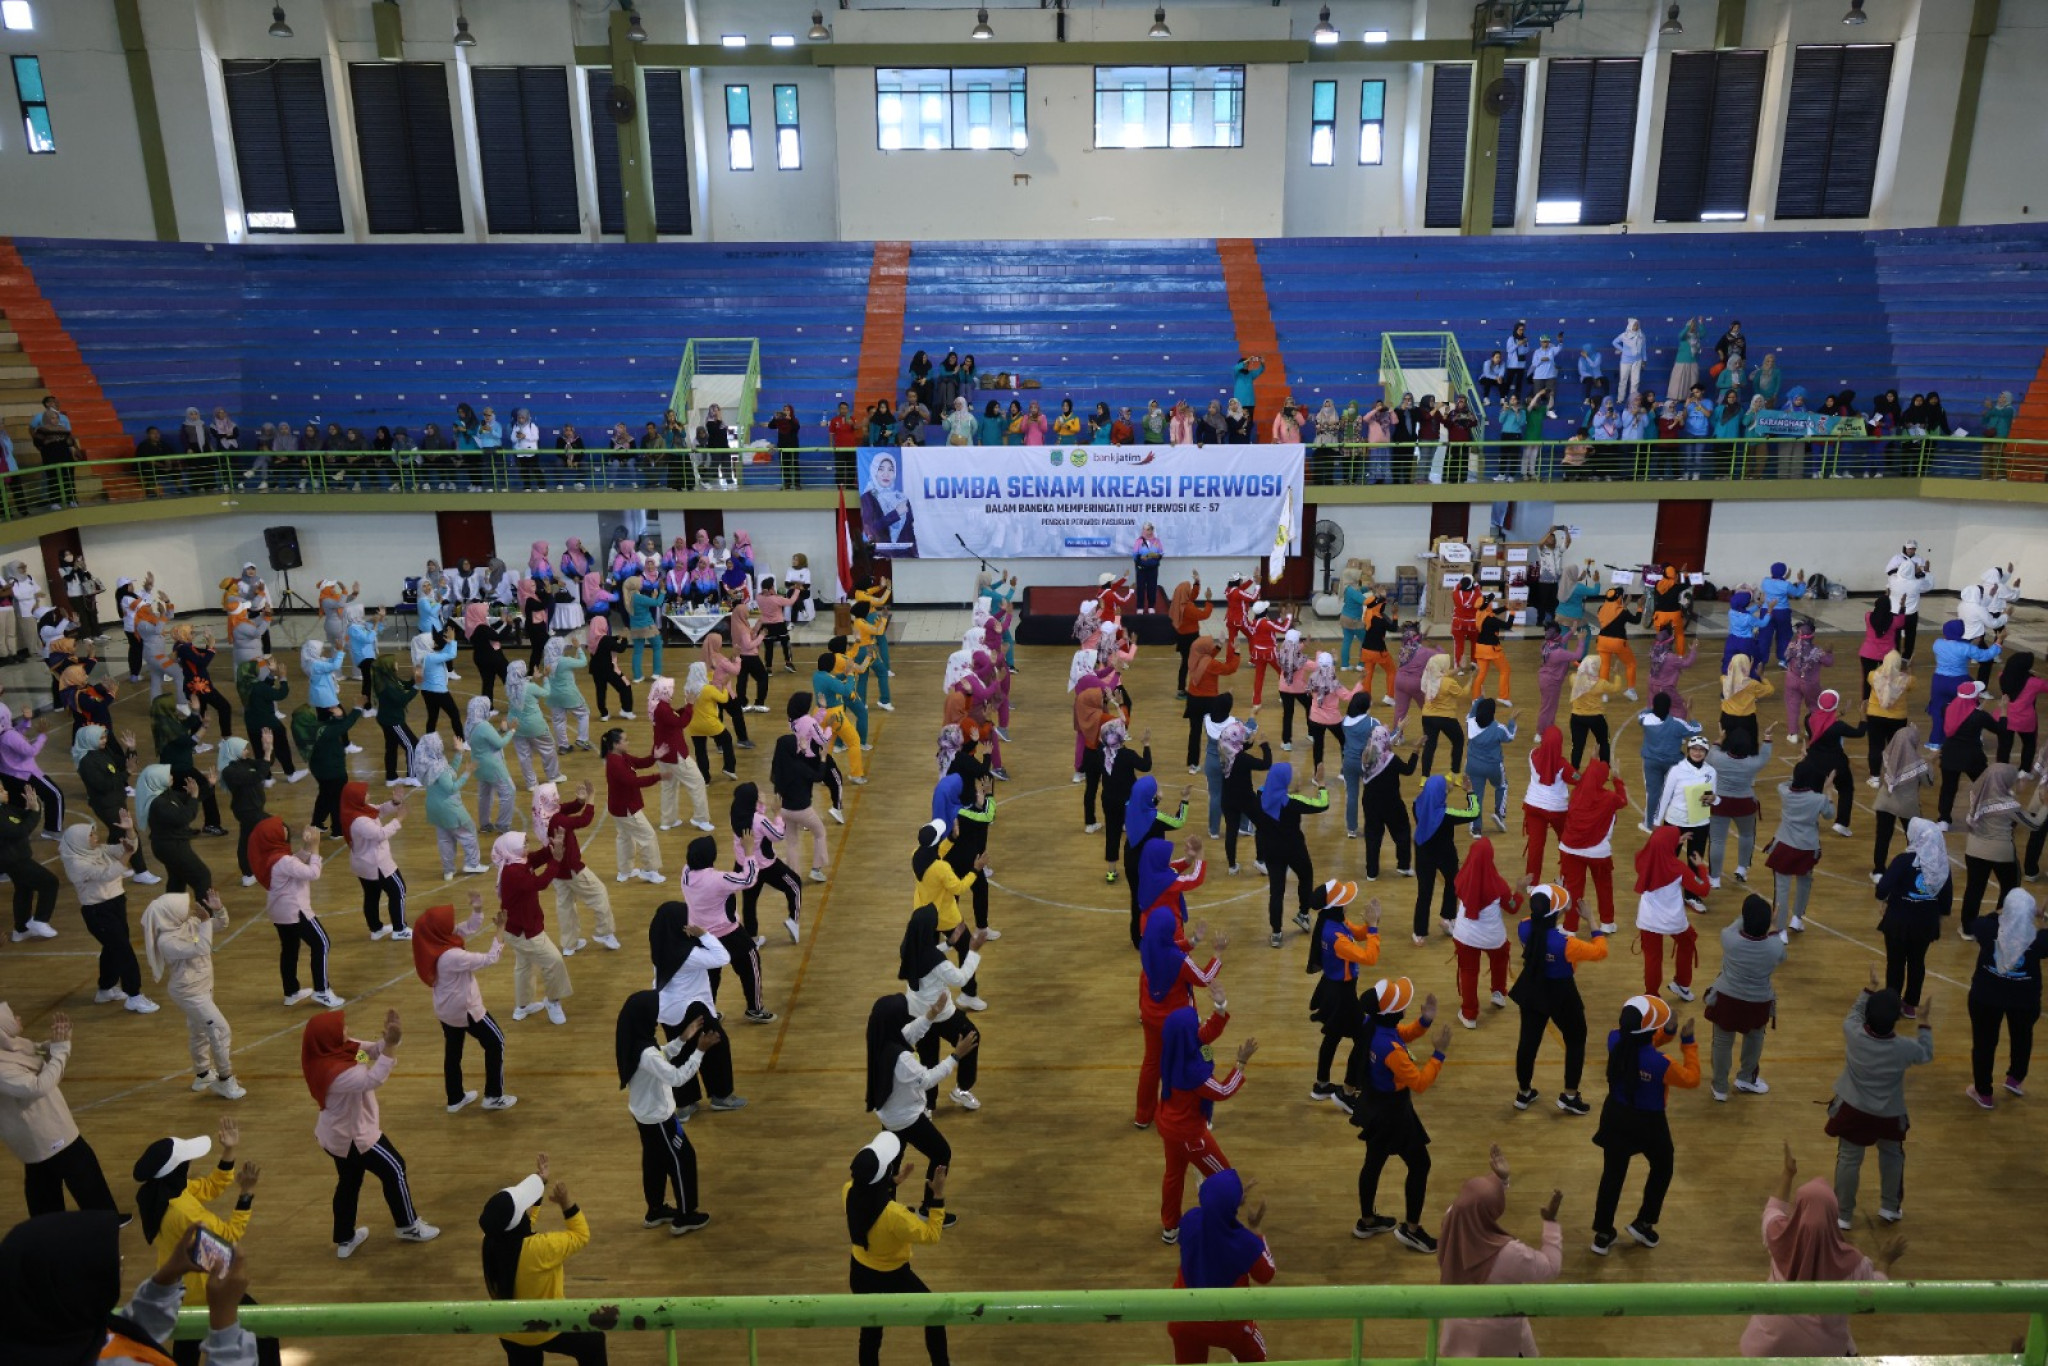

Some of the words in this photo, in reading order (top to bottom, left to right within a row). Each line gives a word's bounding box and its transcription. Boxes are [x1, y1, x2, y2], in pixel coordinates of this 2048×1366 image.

[1093, 453, 1141, 464] bankjatim
[923, 476, 1001, 499] LOMBA
[1007, 475, 1085, 498] SENAM
[1091, 475, 1172, 498] KREASI
[1178, 474, 1282, 498] PERWOSI
[985, 503, 1017, 513] DALAM
[1018, 503, 1054, 513] RANGKA
[1056, 503, 1124, 513] MEMPERINGATI
[1126, 503, 1143, 512] HUT
[1145, 503, 1187, 512] PERWOSI
[1189, 503, 1200, 512] KE
[1209, 503, 1220, 512] 57
